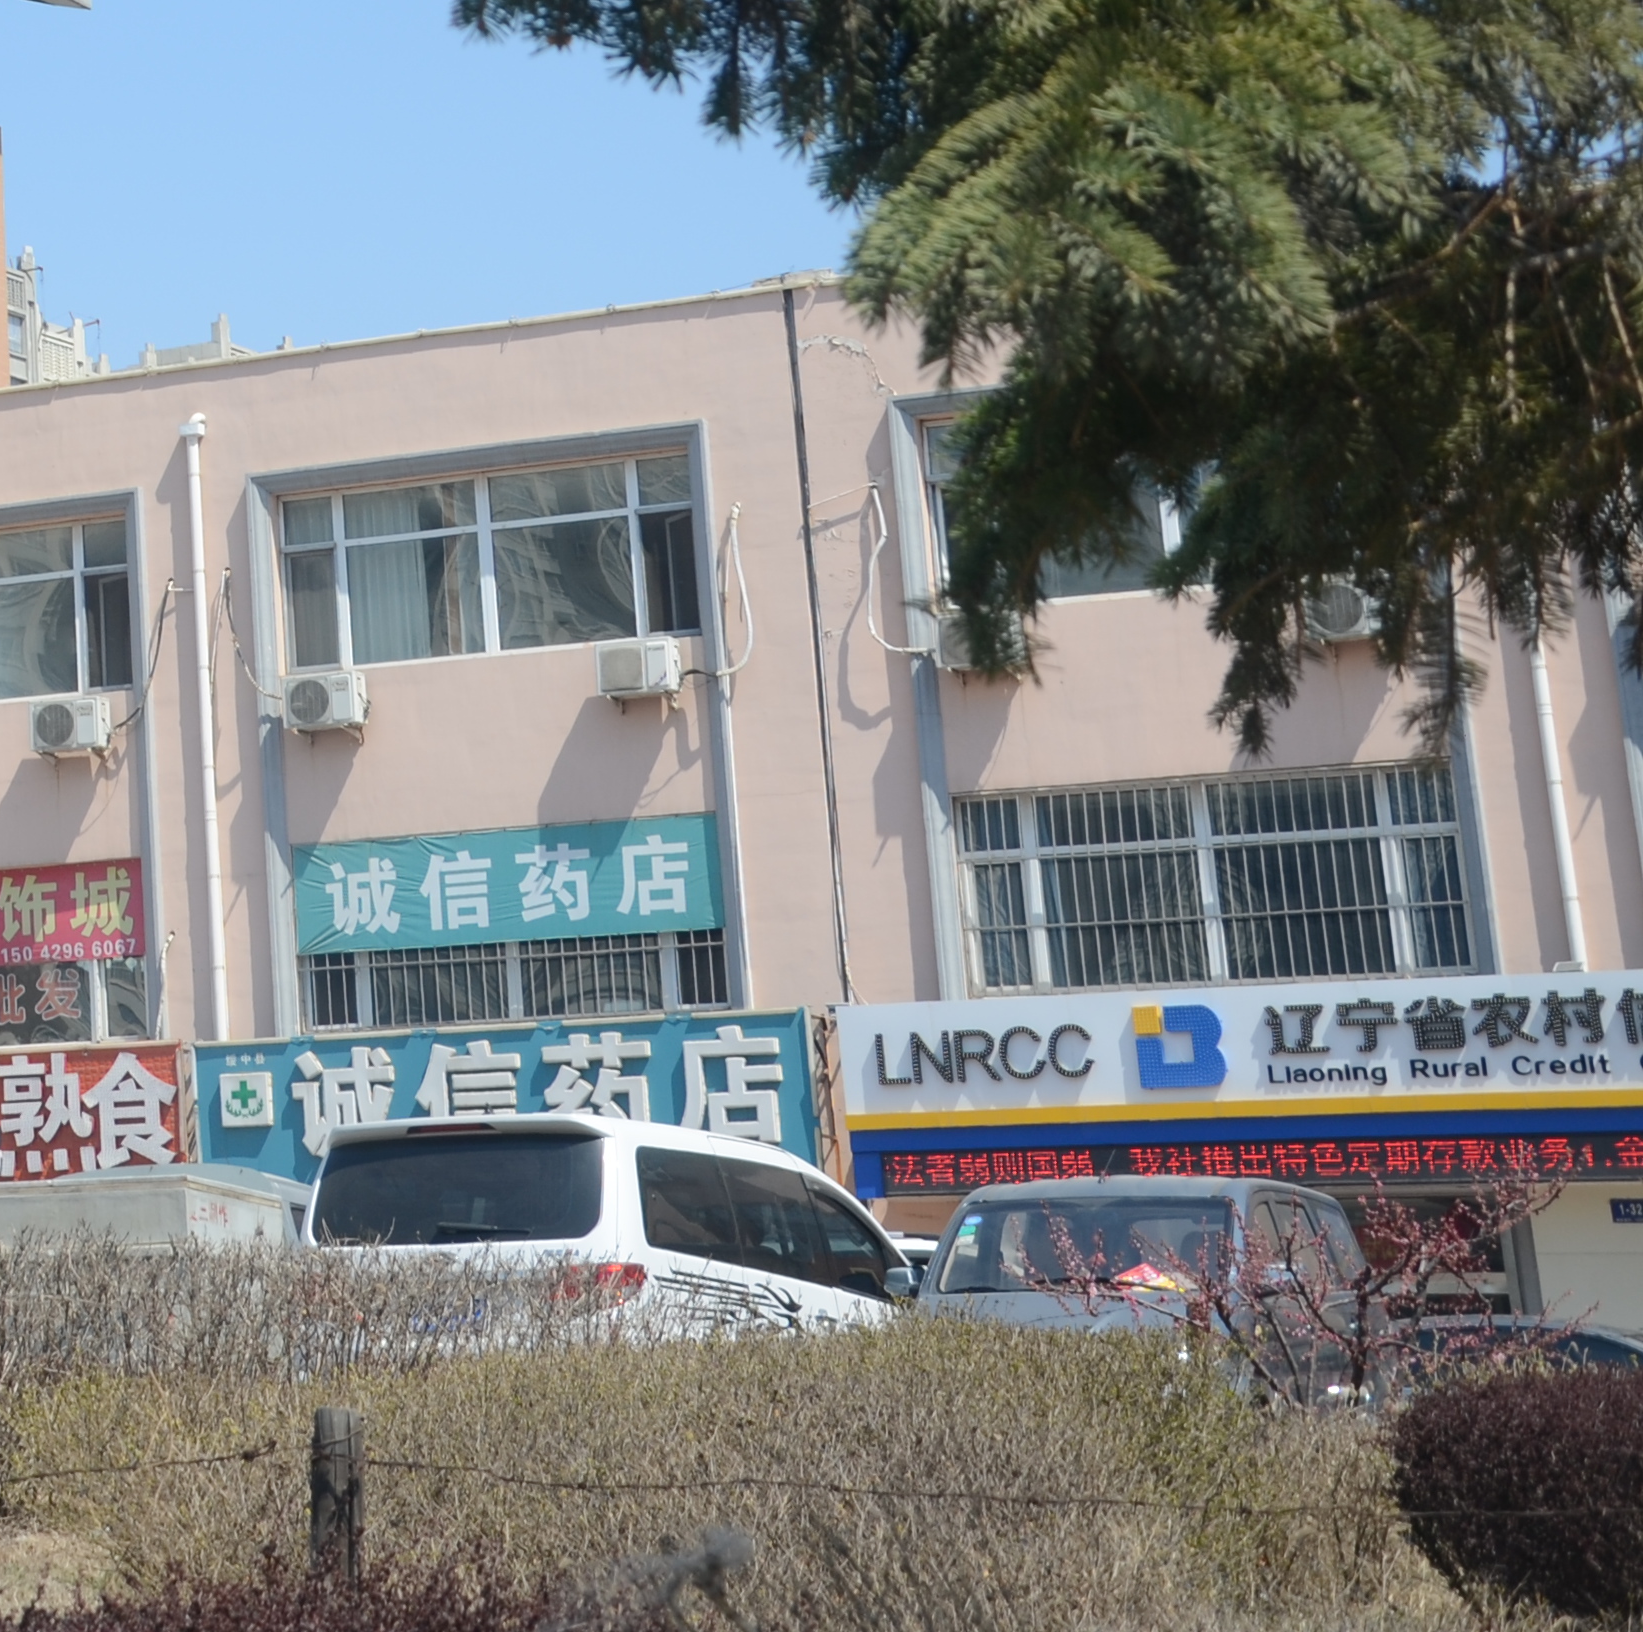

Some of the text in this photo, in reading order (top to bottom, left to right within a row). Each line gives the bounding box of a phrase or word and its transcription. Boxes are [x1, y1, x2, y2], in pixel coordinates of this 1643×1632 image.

[325, 835, 690, 935] 诚信药店
[1, 947, 33, 965] 150
[40, 943, 85, 960] 4296
[91, 938, 137, 956] 6067
[874, 1023, 1096, 1086] LNRCC
[1267, 1064, 1388, 1086] Liaoning
[1410, 1056, 1488, 1079] Rural
[1511, 1053, 1612, 1077] Credit
[292, 1025, 784, 1157] 诚信药店
